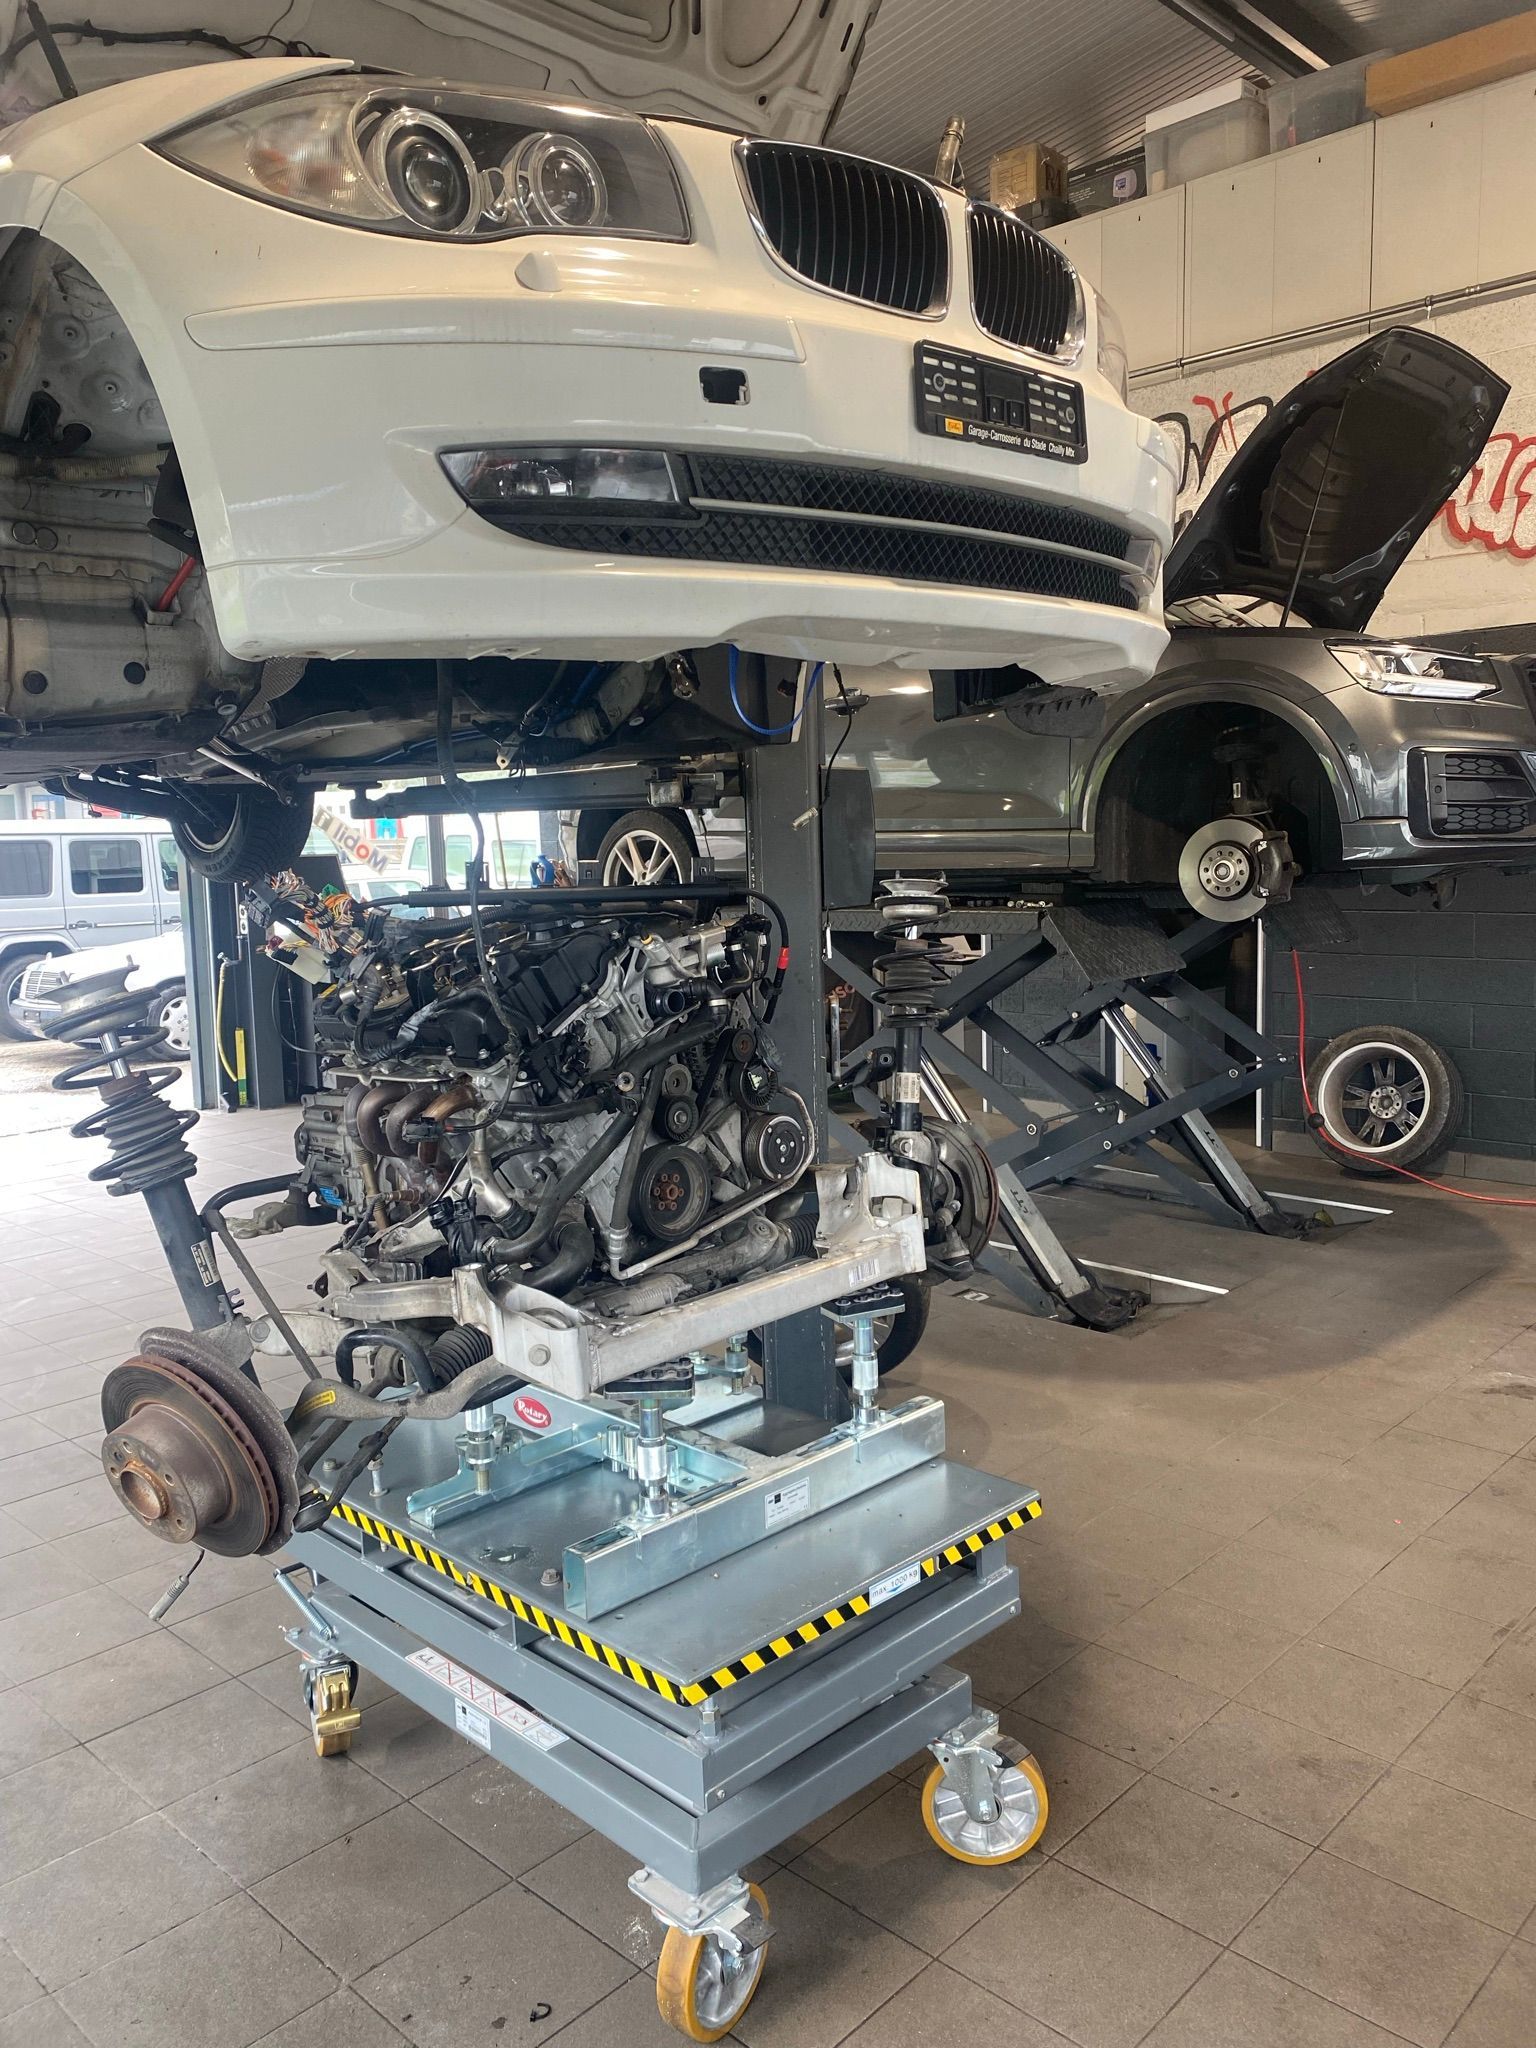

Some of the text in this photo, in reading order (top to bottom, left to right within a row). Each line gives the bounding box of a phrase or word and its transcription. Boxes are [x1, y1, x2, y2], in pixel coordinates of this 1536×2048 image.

[968, 424, 1021, 446] Garage-Carrosserie
[1023, 437, 1031, 448] du
[1031, 438, 1047, 451] Stade
[1048, 442, 1065, 457] Chailly
[514, 1398, 548, 1421] Rotary
[890, 1573, 908, 1587] 1000
